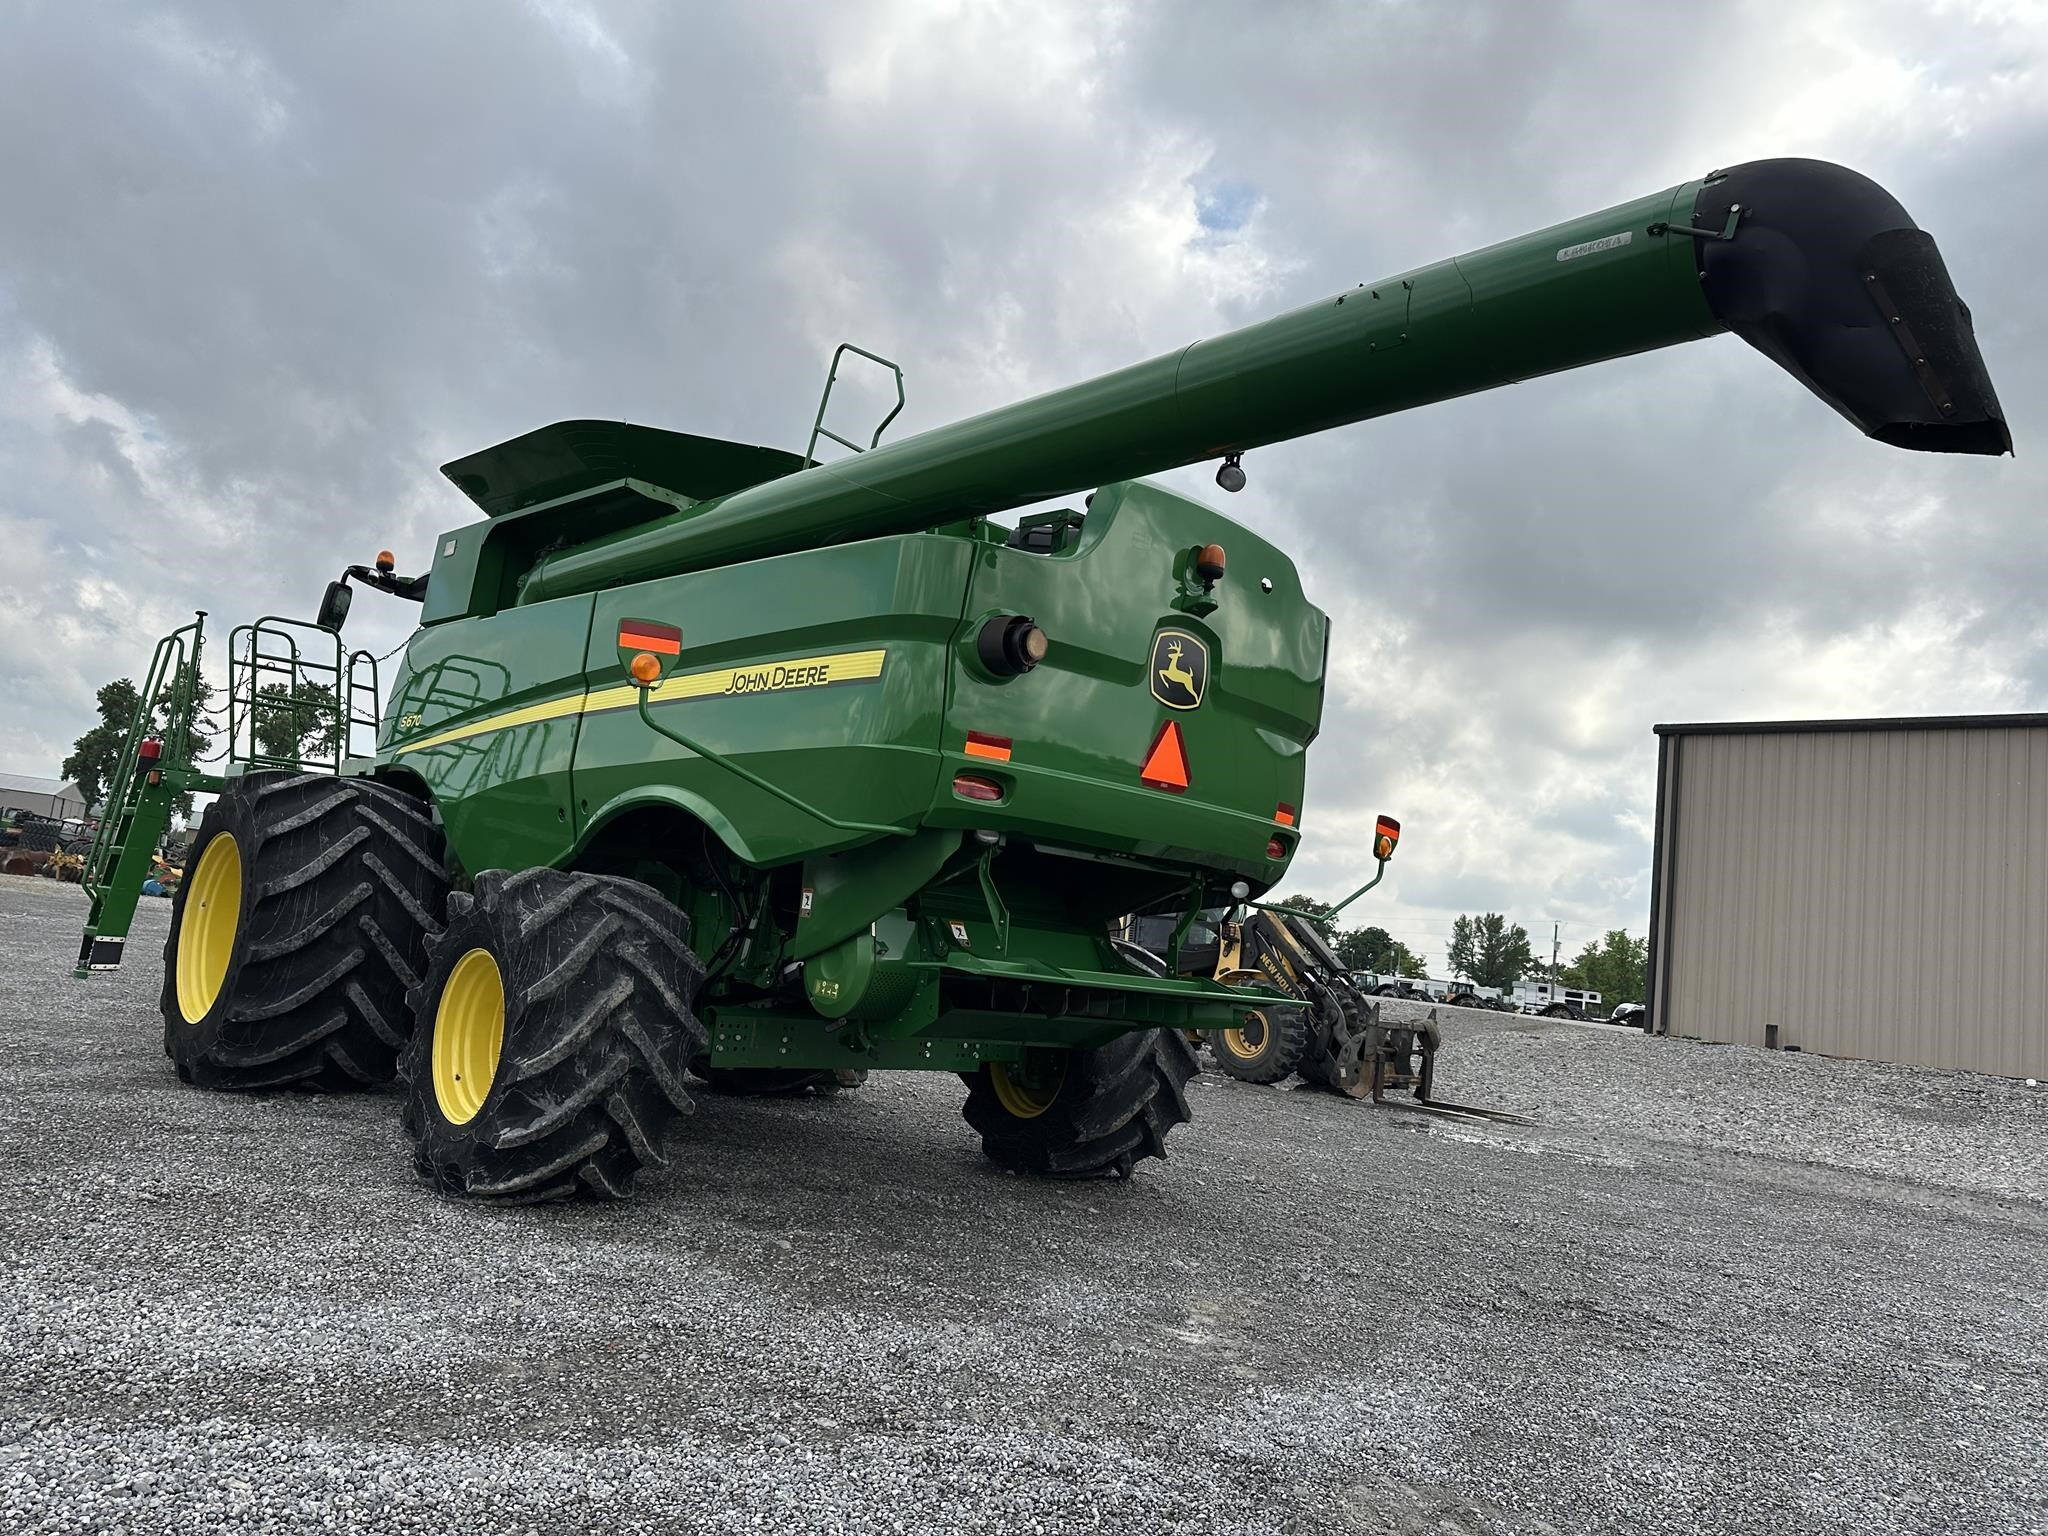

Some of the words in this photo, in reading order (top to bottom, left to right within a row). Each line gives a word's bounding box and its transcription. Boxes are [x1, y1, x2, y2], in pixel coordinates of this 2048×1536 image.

[725, 671, 770, 692] JOHN
[771, 664, 830, 688] DEERE
[400, 714, 422, 728] S670
[1259, 952, 1278, 975] NEW
